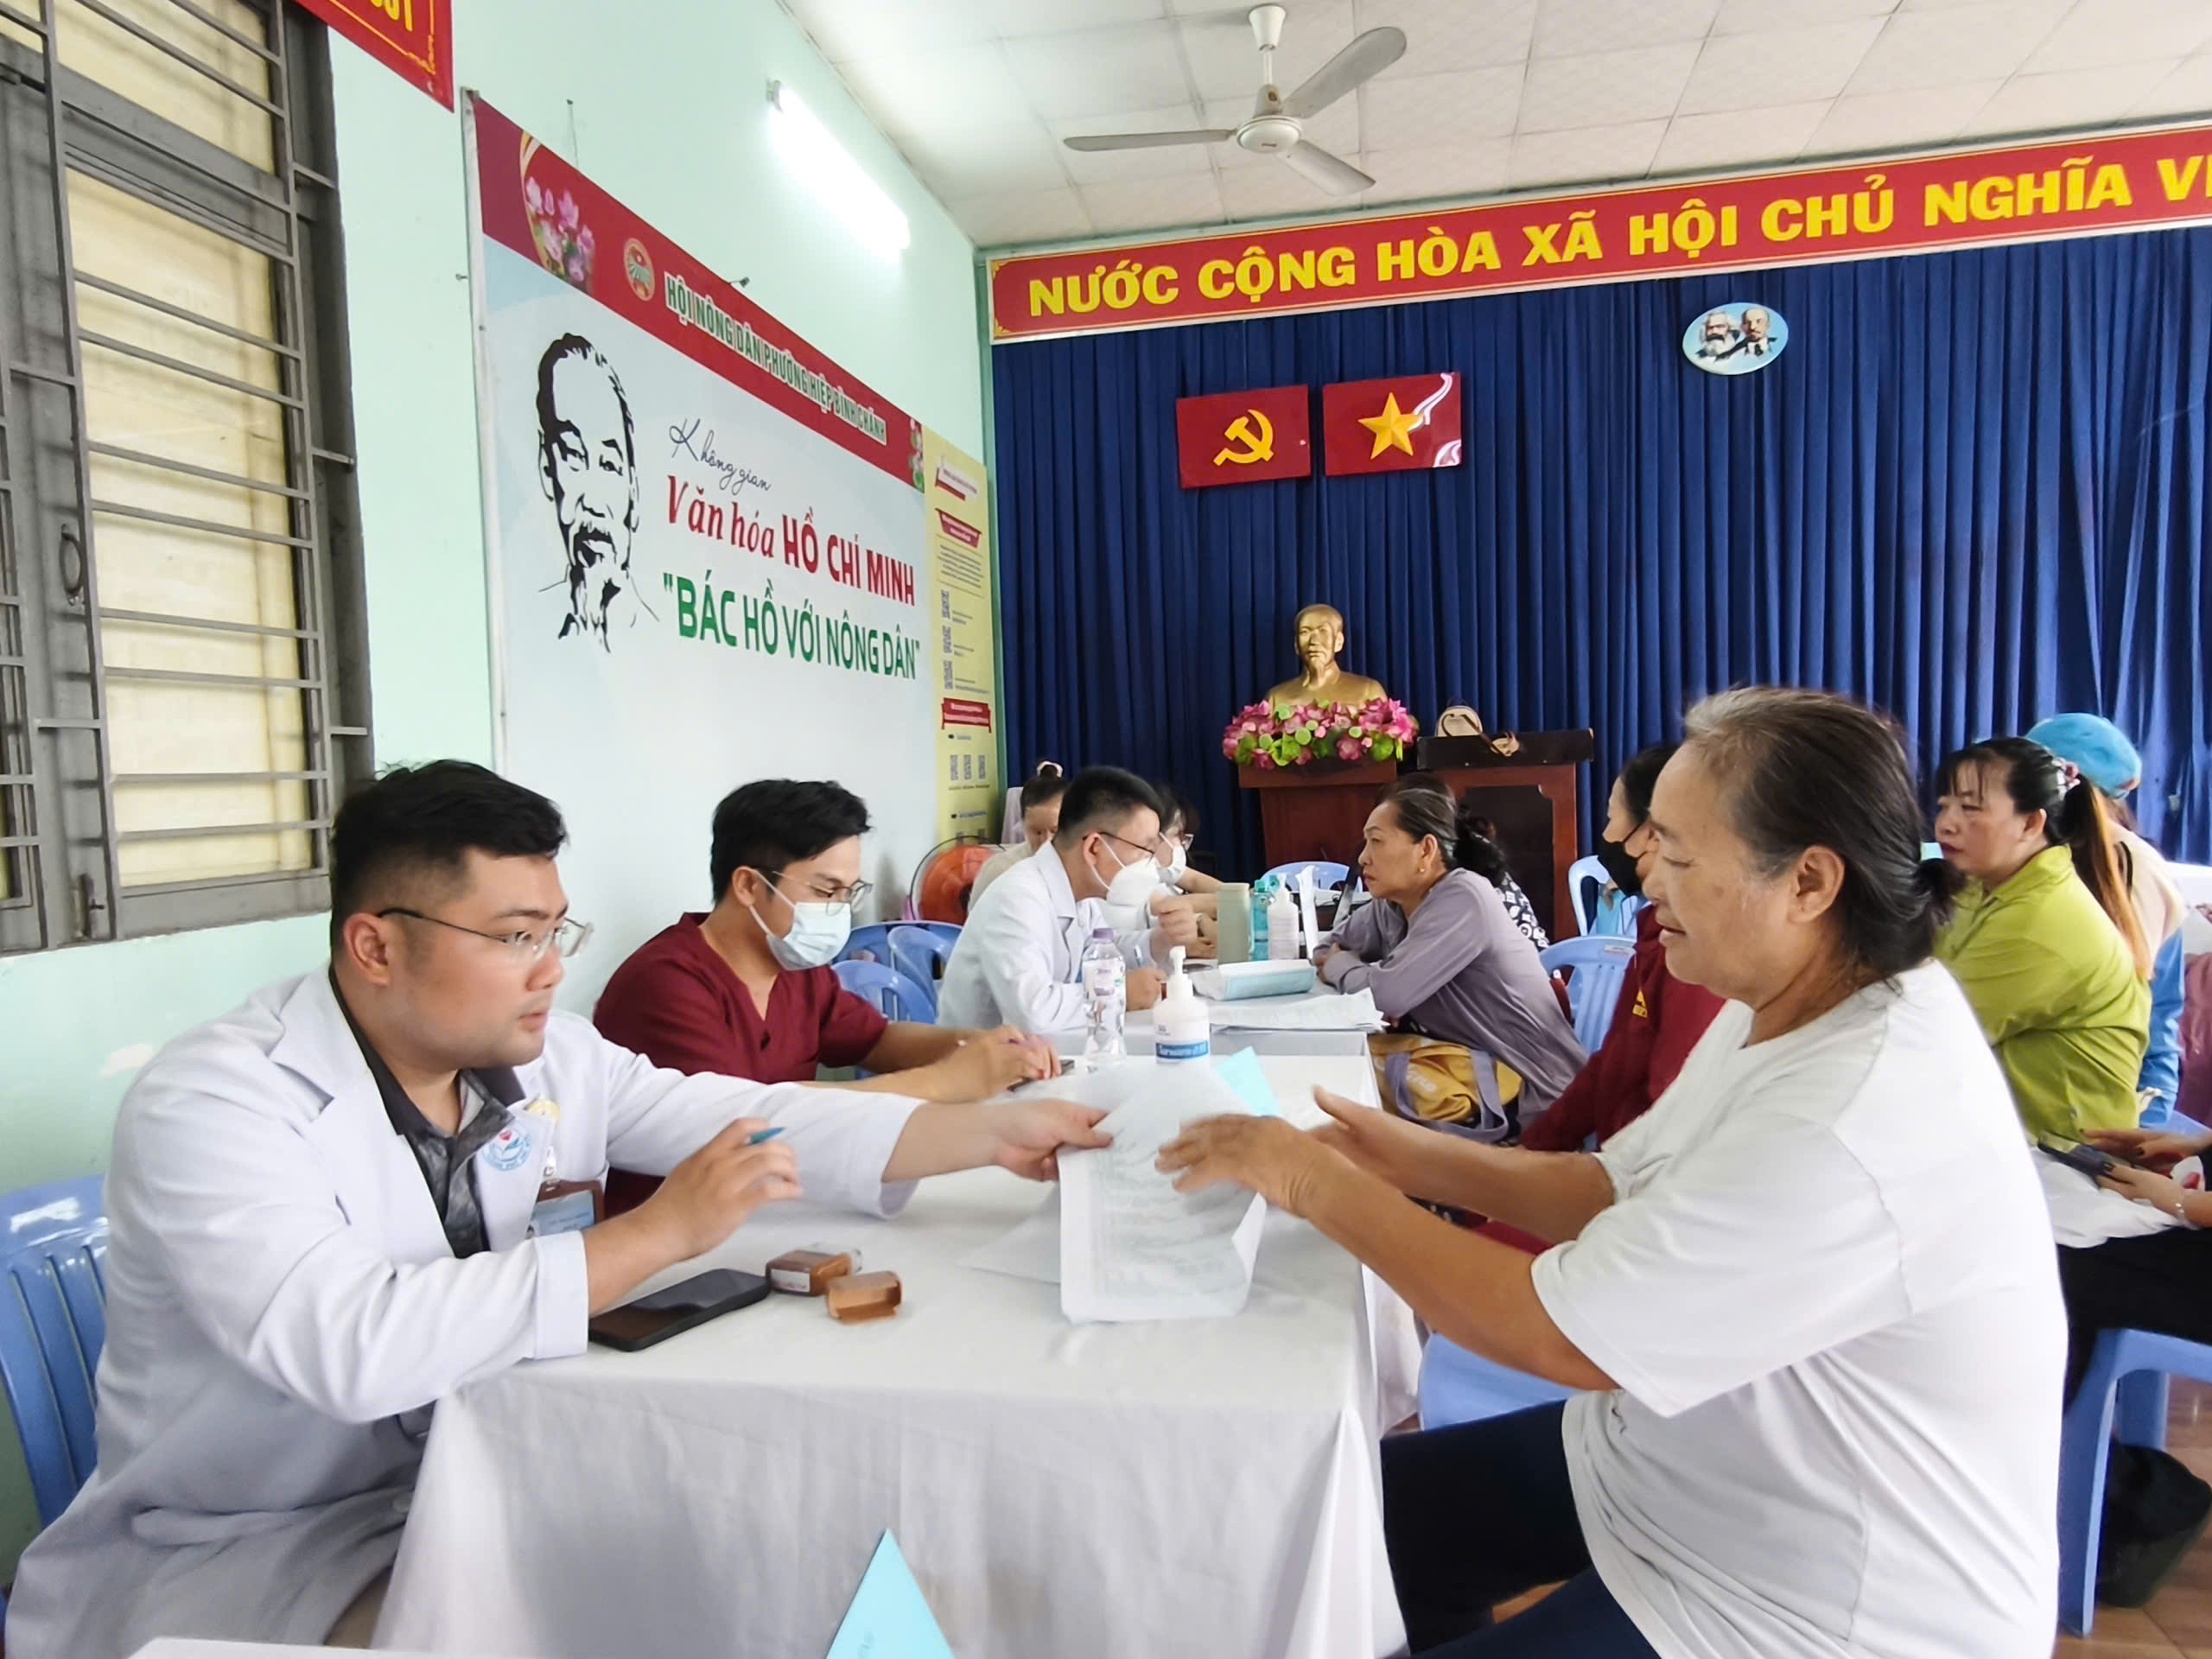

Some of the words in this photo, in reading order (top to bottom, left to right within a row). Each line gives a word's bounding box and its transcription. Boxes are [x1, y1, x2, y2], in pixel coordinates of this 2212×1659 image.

[1028, 259, 1179, 317] NƯỚC
[1198, 245, 1357, 303] CỘNG
[1376, 226, 1502, 282] HÒA
[1522, 209, 1603, 266] XÃ
[1629, 198, 1738, 258] HỘI
[1760, 174, 1895, 241] CHỦ
[1923, 156, 2133, 226] NGHĨA
[664, 272, 693, 326] HỘI
[694, 294, 734, 347] NÔNG
[734, 321, 762, 366] DÂN
[809, 372, 832, 414] HIỆP
[668, 418, 737, 492] Không
[731, 467, 772, 496] gian
[667, 474, 723, 541] Văn
[731, 501, 774, 559] hóa
[781, 506, 819, 574] HỒ
[827, 533, 861, 589] CHÍ
[866, 548, 916, 607] MINH
[743, 577, 779, 656] HỒ
[782, 598, 822, 664] VỚI
[826, 609, 880, 674] NÔNG
